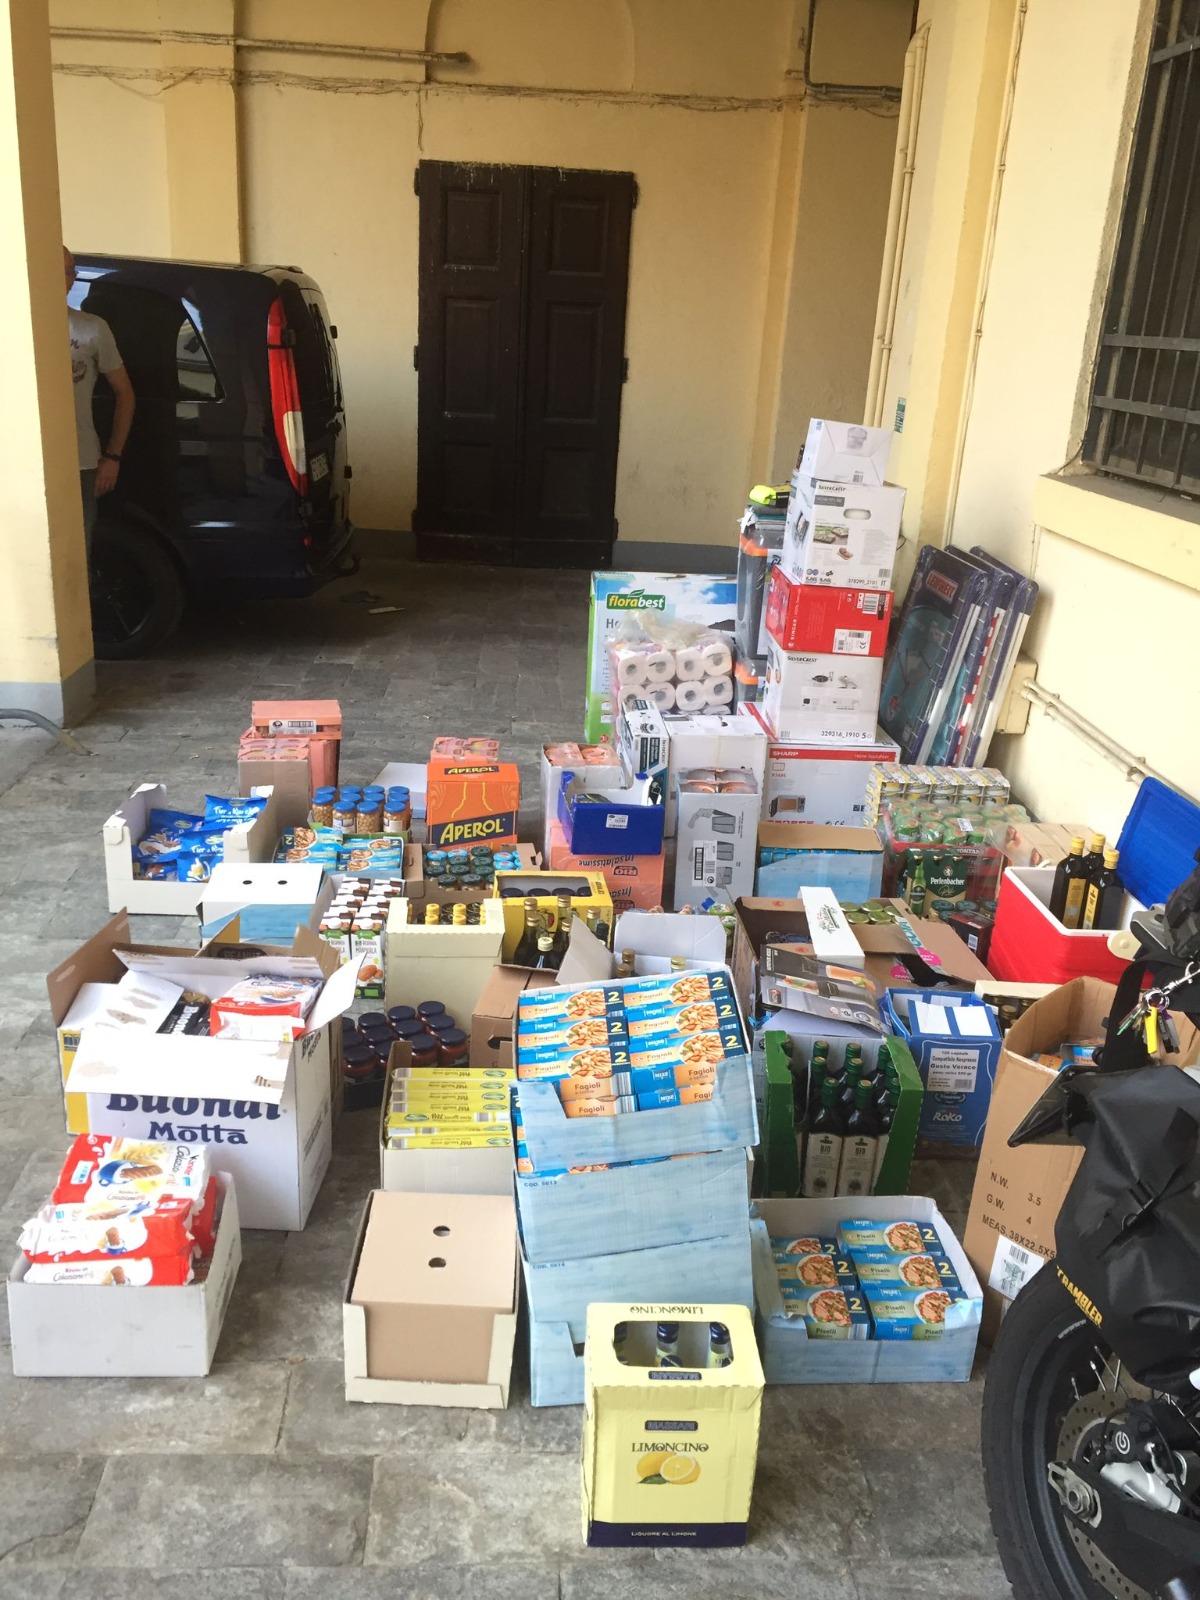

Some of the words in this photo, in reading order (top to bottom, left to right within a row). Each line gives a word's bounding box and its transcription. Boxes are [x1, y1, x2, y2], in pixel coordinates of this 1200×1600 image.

[927, 573, 955, 601] LEIFHEIT
[608, 595, 664, 608] florabest
[820, 730, 860, 739] 329316_1910
[448, 767, 496, 775] APEROL
[439, 818, 504, 845] APEROL
[930, 877, 965, 885] Perlenbacher
[712, 976, 724, 988] 2
[608, 991, 620, 1001] 2
[720, 1004, 733, 1016] 2
[610, 1022, 623, 1032] 2
[725, 1035, 738, 1047] 2
[614, 1051, 627, 1063] 2
[646, 1051, 673, 1060] Fagioli
[688, 1067, 715, 1077] Fagioli
[574, 1082, 601, 1091] Fagioli
[578, 1105, 605, 1114] Fagioli
[147, 1121, 248, 1144] Motta
[990, 1171, 1009, 1189] N.W.
[1027, 1192, 1042, 1206] 3.5
[986, 1193, 1005, 1211] G.W.
[1026, 1216, 1032, 1225] 4
[922, 1228, 935, 1240] 2
[825, 1244, 837, 1255] 2
[837, 1261, 850, 1273] 2
[938, 1262, 951, 1274] 2
[849, 1297, 863, 1310] 2
[630, 1306, 704, 1315] LIMONCINO
[816, 1327, 837, 1335] Piselli
[631, 1442, 709, 1452] LIMONCINO
